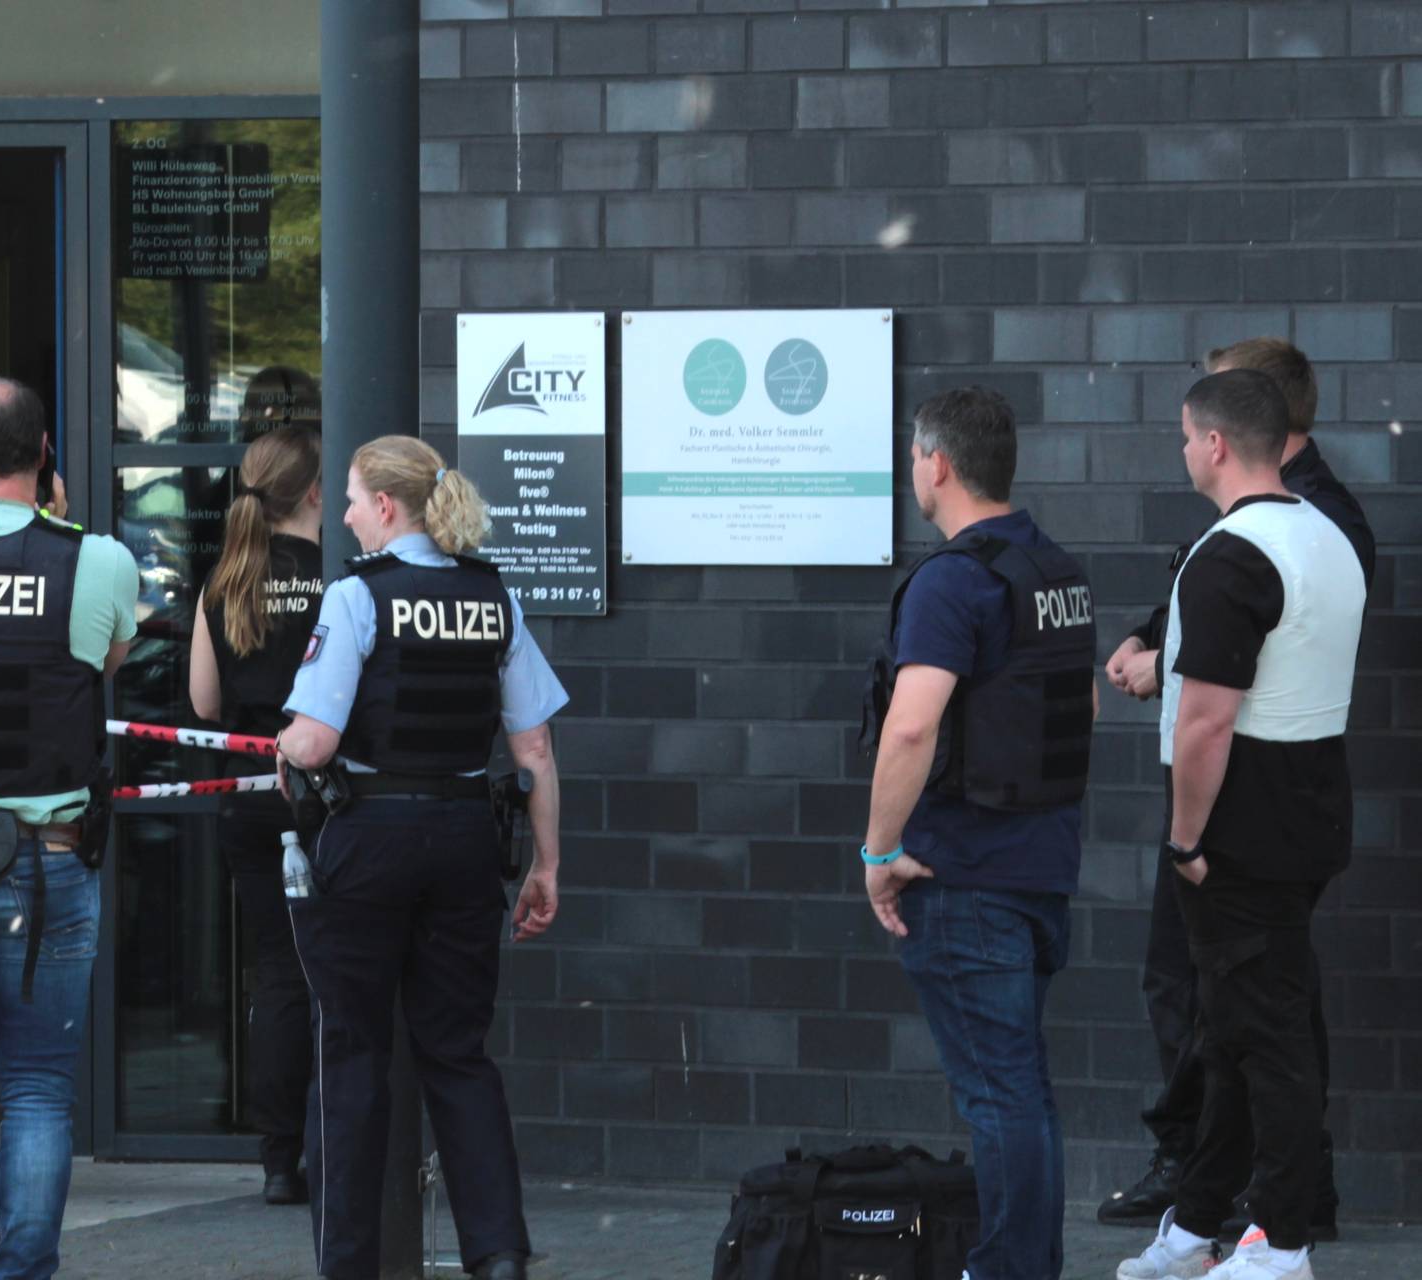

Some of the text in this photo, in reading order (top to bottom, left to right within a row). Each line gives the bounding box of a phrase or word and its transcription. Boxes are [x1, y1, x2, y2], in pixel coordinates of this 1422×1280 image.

[146, 138, 166, 149] OG
[132, 160, 157, 171] Willi
[132, 174, 221, 187] Finanzierungen
[224, 173, 287, 185] Immobilien
[132, 188, 275, 201] HS Wohnungsbau GmbH
[132, 202, 259, 216] BL Bauleitungs GmbH
[132, 237, 169, 247] Mo-Do
[172, 239, 191, 247] von
[194, 236, 218, 247] 8.00
[221, 236, 241, 246] Uhr
[244, 236, 259, 246] bis
[295, 235, 315, 246] Uhr
[132, 251, 144, 261] Fr
[147, 253, 167, 261] von
[170, 251, 193, 261] 8.00
[197, 250, 216, 261] Uhr
[219, 250, 234, 261] bis
[132, 265, 257, 278] und nach Vereinbarung
[510, 370, 586, 393] CITY
[543, 393, 587, 402] FITNESS
[689, 427, 824, 438] Dr. med. Volker Semmler
[504, 449, 564, 464] Betreuung
[522, 504, 531, 516] &
[534, 504, 587, 517] Wellness
[512, 522, 557, 537] Testing
[567, 556, 579, 564] Uhr
[585, 565, 597, 573] Uhr
[533, 587, 547, 600] 99
[551, 587, 564, 600] 31
[568, 587, 583, 600] 67
[592, 587, 601, 600] 0
[266, 597, 309, 614] MND
[392, 598, 505, 640] POLIZEI
[843, 1208, 895, 1222] POLIZEI
